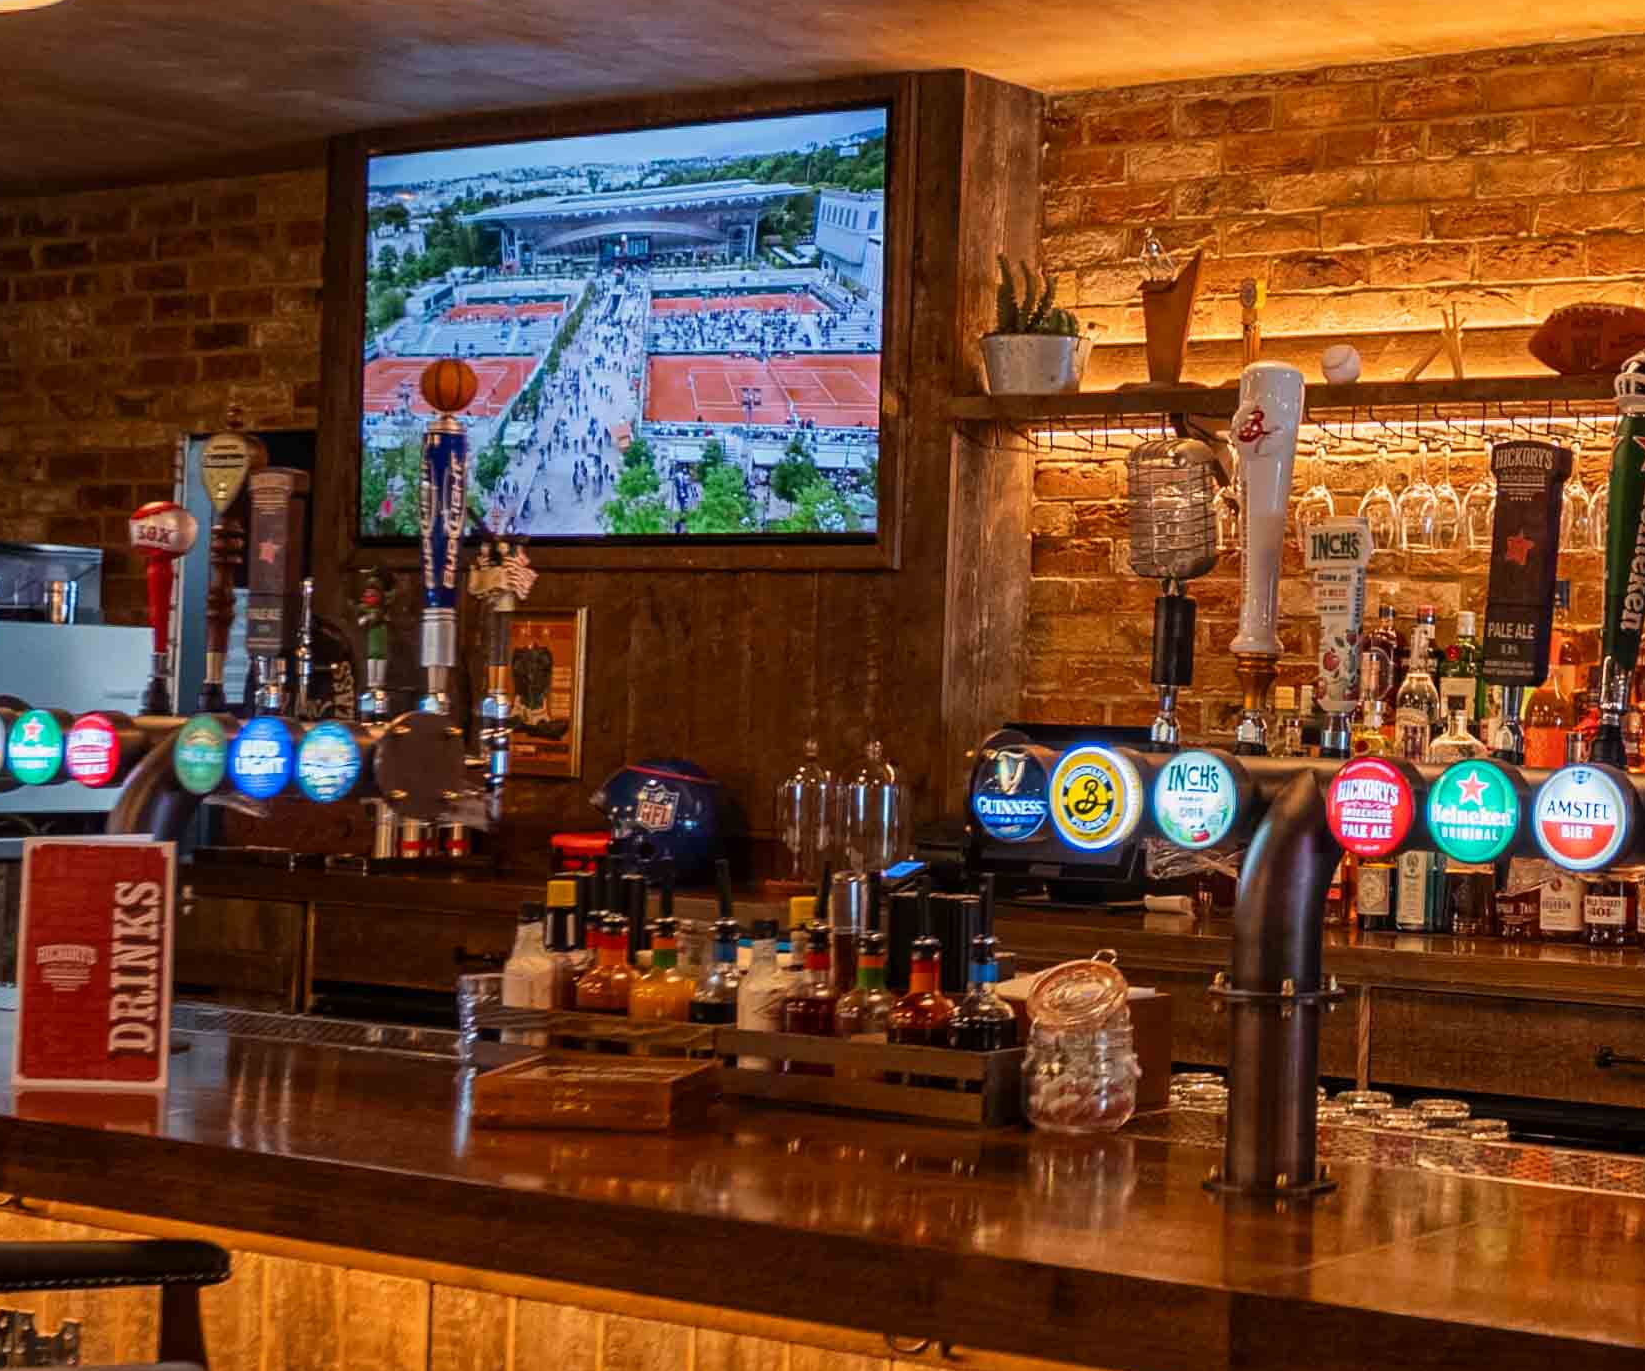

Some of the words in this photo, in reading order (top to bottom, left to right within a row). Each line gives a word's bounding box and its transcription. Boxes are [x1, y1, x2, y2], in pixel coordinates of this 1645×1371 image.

[1487, 622, 1515, 638] PALE
[1516, 623, 1535, 640] ALE
[235, 756, 288, 774] LIGHT
[977, 796, 1047, 817] GUINNESS
[1431, 804, 1515, 826] Heineken
[1546, 801, 1611, 820] AMSTEL
[1341, 824, 1368, 838] PALE
[1369, 824, 1393, 839] ALE
[1441, 828, 1500, 841] ORIGINAL
[1561, 827, 1594, 840] BIER
[107, 881, 161, 1054] DRINKS
